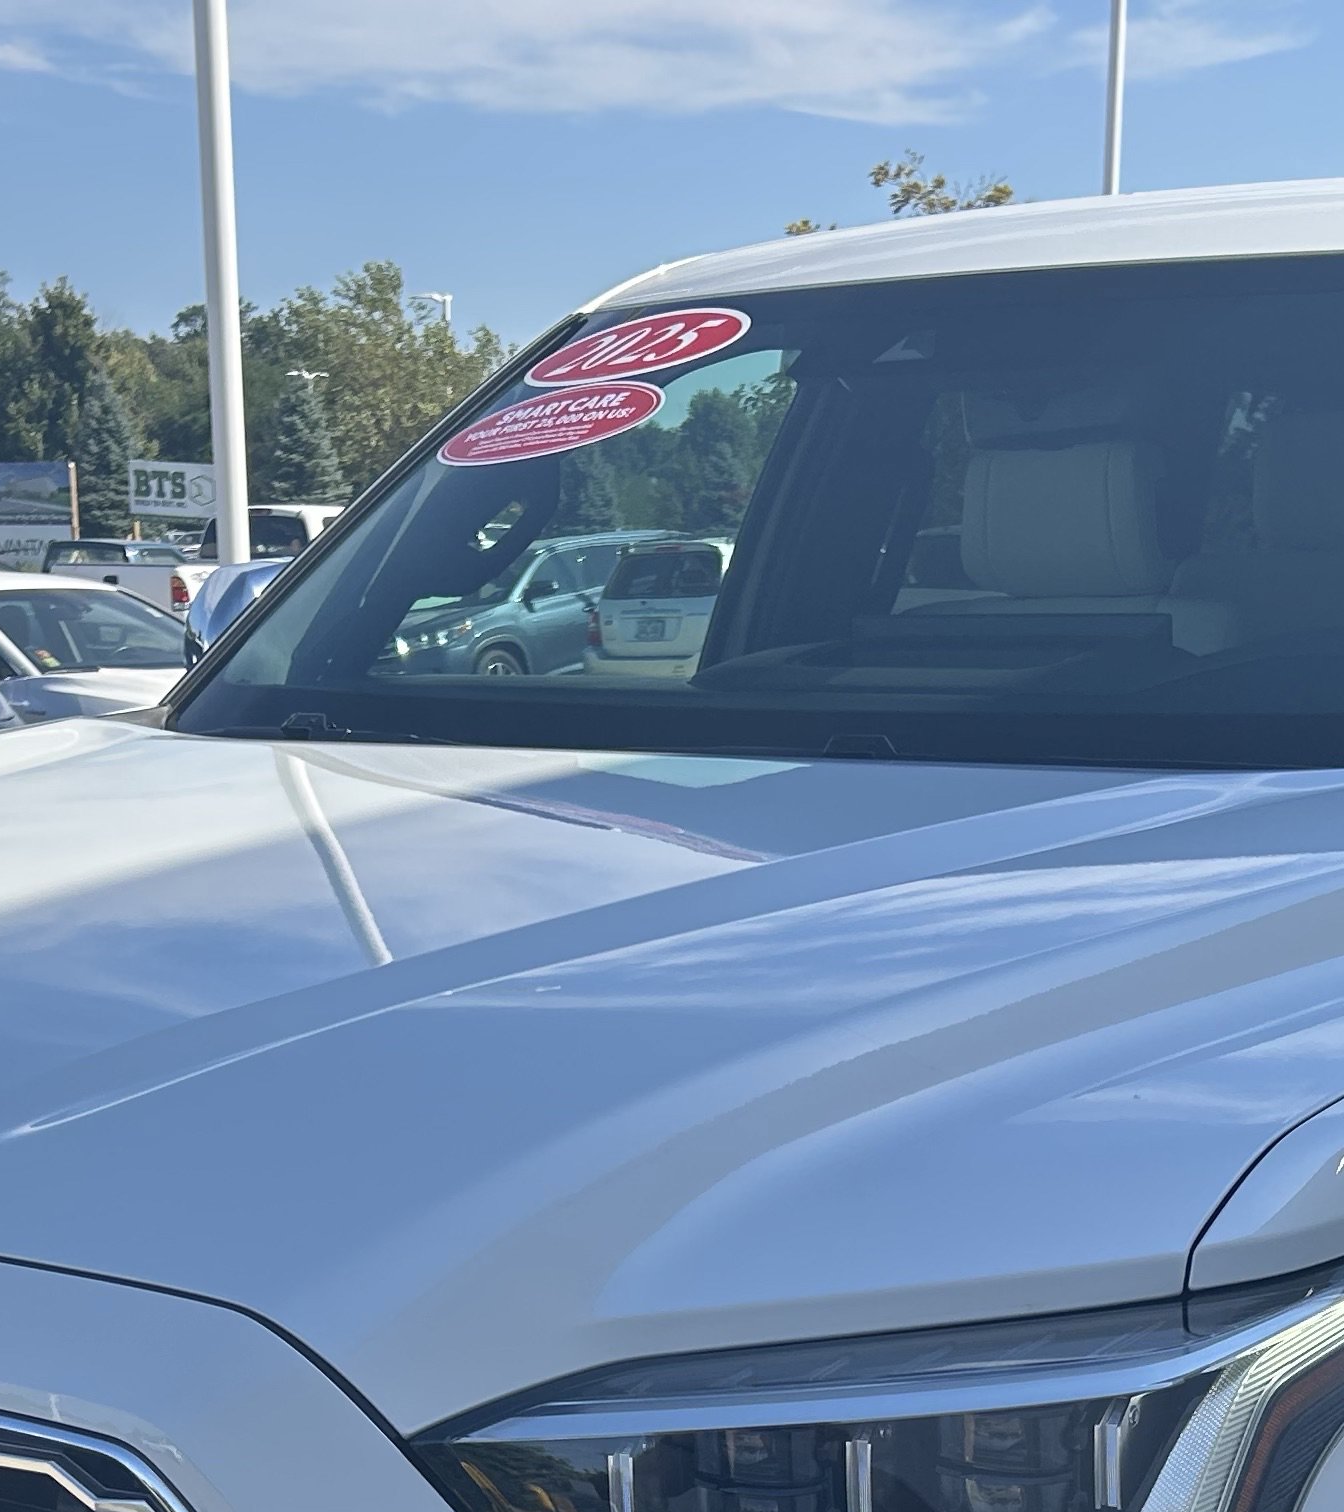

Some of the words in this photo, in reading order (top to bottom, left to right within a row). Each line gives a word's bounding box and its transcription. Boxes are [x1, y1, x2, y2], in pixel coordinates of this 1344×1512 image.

[543, 319, 728, 378] 2025
[495, 400, 573, 426] SMART
[568, 392, 631, 412] CARE
[499, 420, 540, 435] FIRST
[582, 409, 610, 421] ON
[607, 407, 636, 419] US!
[134, 470, 187, 499] BTS
